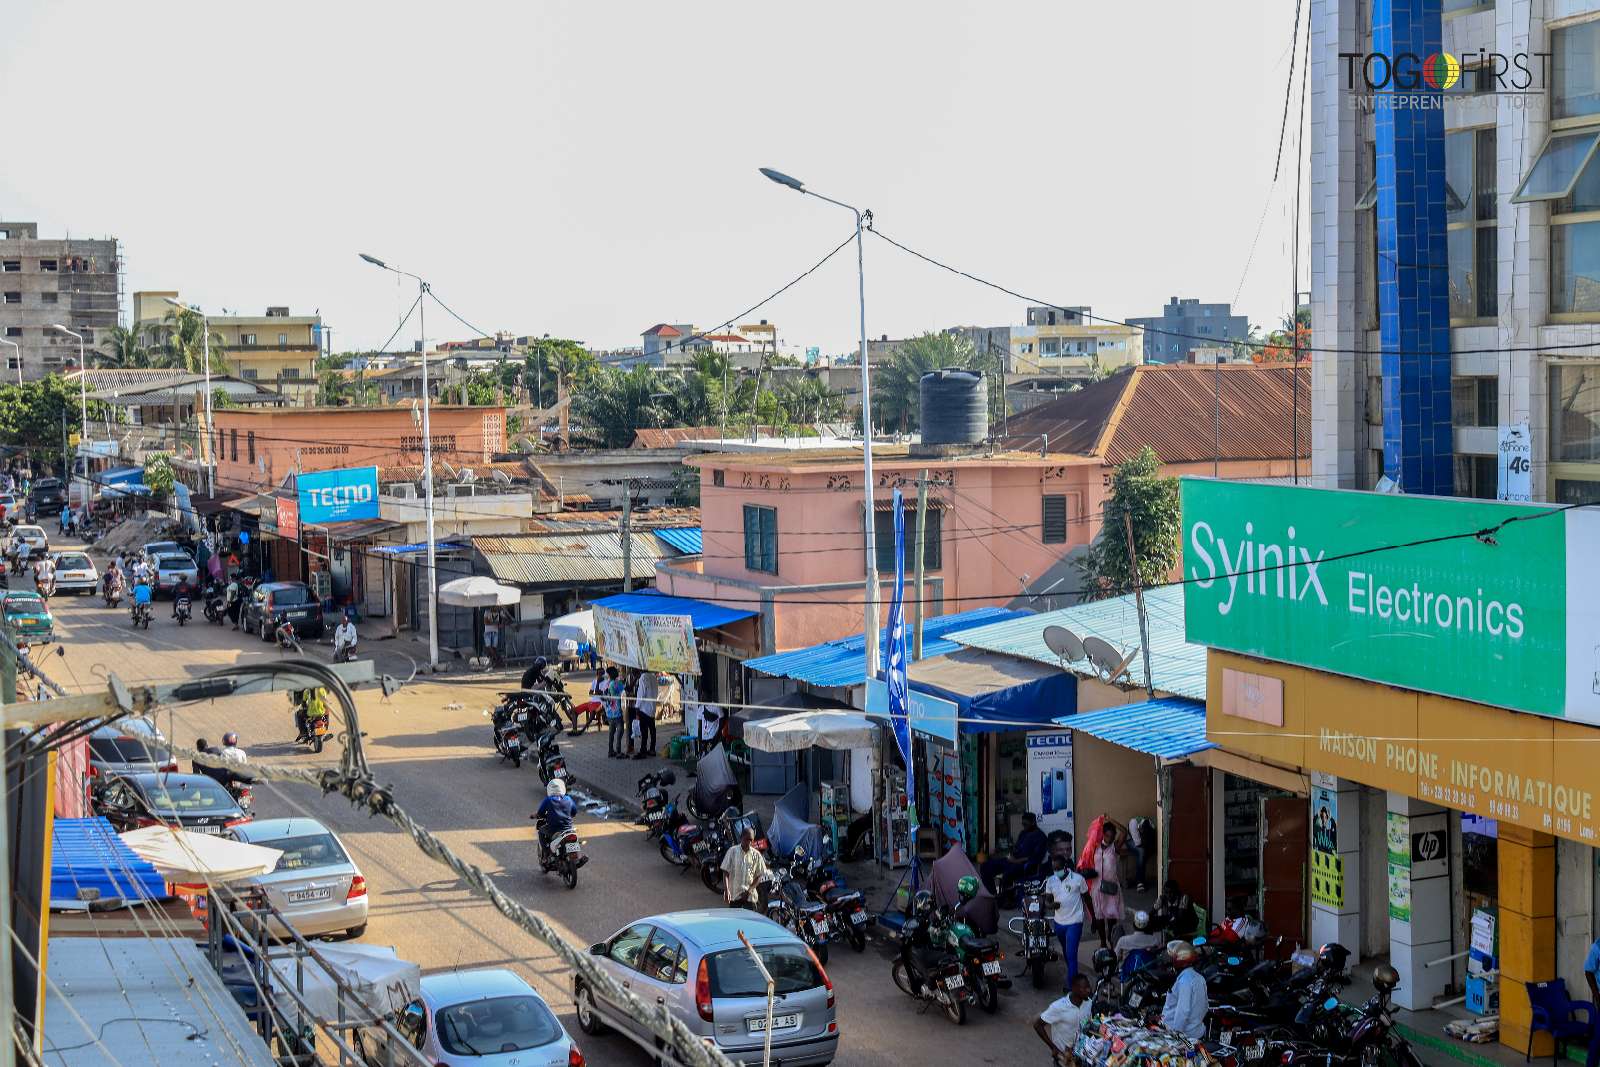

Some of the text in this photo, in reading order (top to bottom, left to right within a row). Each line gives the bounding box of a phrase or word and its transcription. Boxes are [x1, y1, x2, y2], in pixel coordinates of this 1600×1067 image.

[1509, 456, 1530, 475] 4G
[308, 484, 372, 507] TECNO
[1191, 521, 1524, 639] Syinix Electronics
[1320, 727, 1592, 819] MAISON PHONE INFORMATIQUE
[1421, 832, 1437, 860] hp
[757, 1017, 779, 1029] 024
